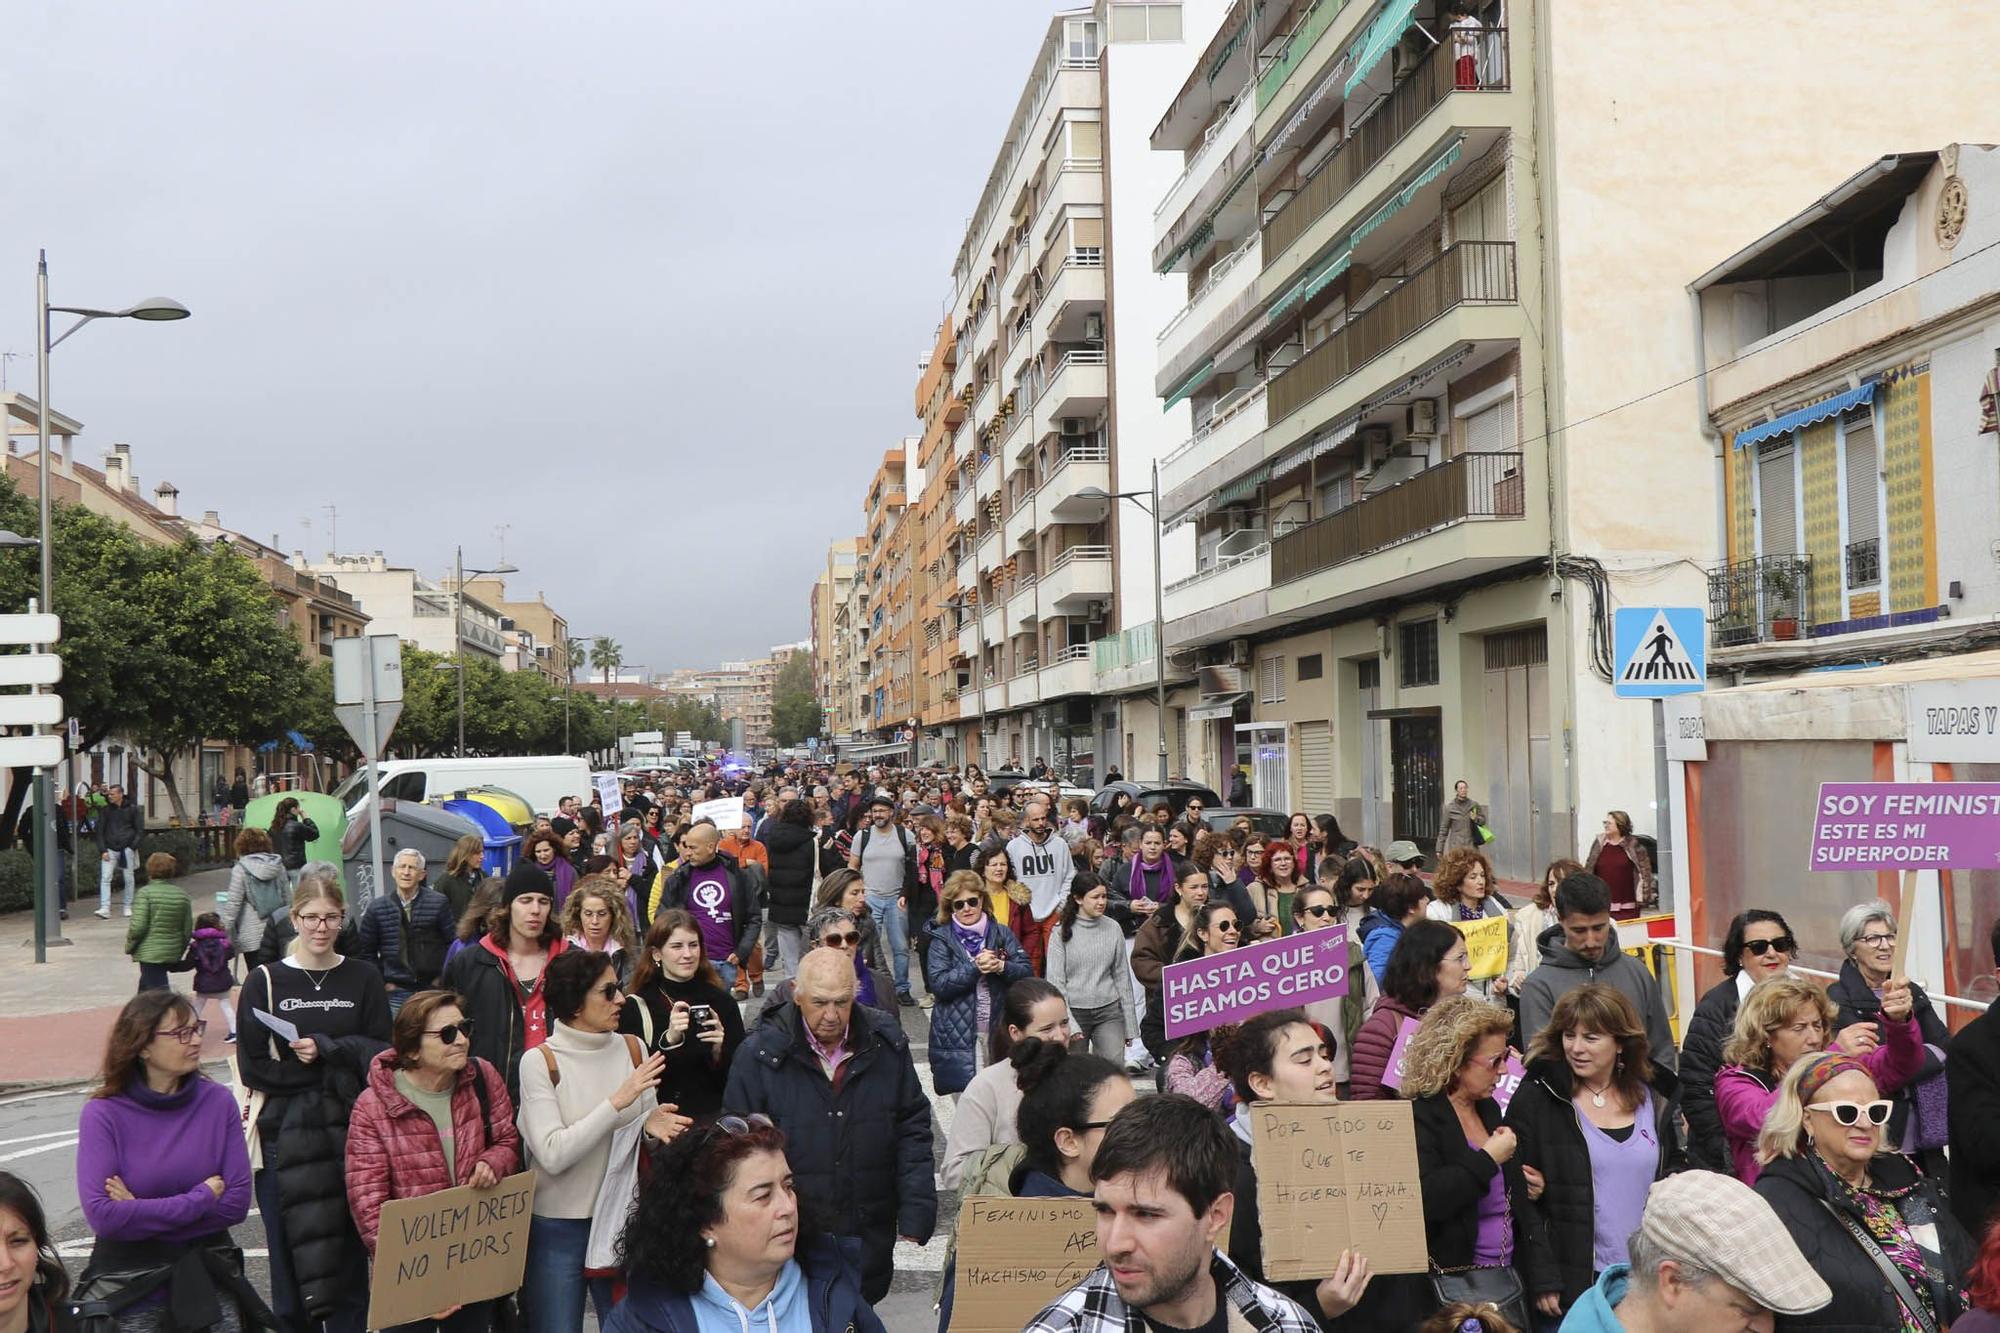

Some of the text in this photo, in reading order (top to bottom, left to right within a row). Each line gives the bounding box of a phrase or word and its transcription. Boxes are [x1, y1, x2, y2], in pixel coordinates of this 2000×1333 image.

[1927, 707, 1997, 734] TAPAS Y
[1823, 795, 2000, 815] SOY FEMINIST
[1820, 824, 1869, 839] ESTE
[1874, 824, 1898, 839] ES
[1022, 854, 1055, 876] AU!
[1816, 846, 1949, 862] SUPERPODER
[1169, 945, 1314, 998] HASTA QUE
[280, 998, 354, 1011] Champion
[1170, 965, 1344, 1024] SEAMOS CERO
[1264, 1113, 1305, 1140] POR
[1322, 1116, 1367, 1136] TODO
[1302, 1148, 1366, 1170] QUE TE
[401, 1190, 529, 1246] VOLEM DRETS
[972, 1202, 1083, 1225] FEMINISMO
[397, 1231, 513, 1286] NO FLORS
[967, 1266, 1046, 1287] MACHISMO
